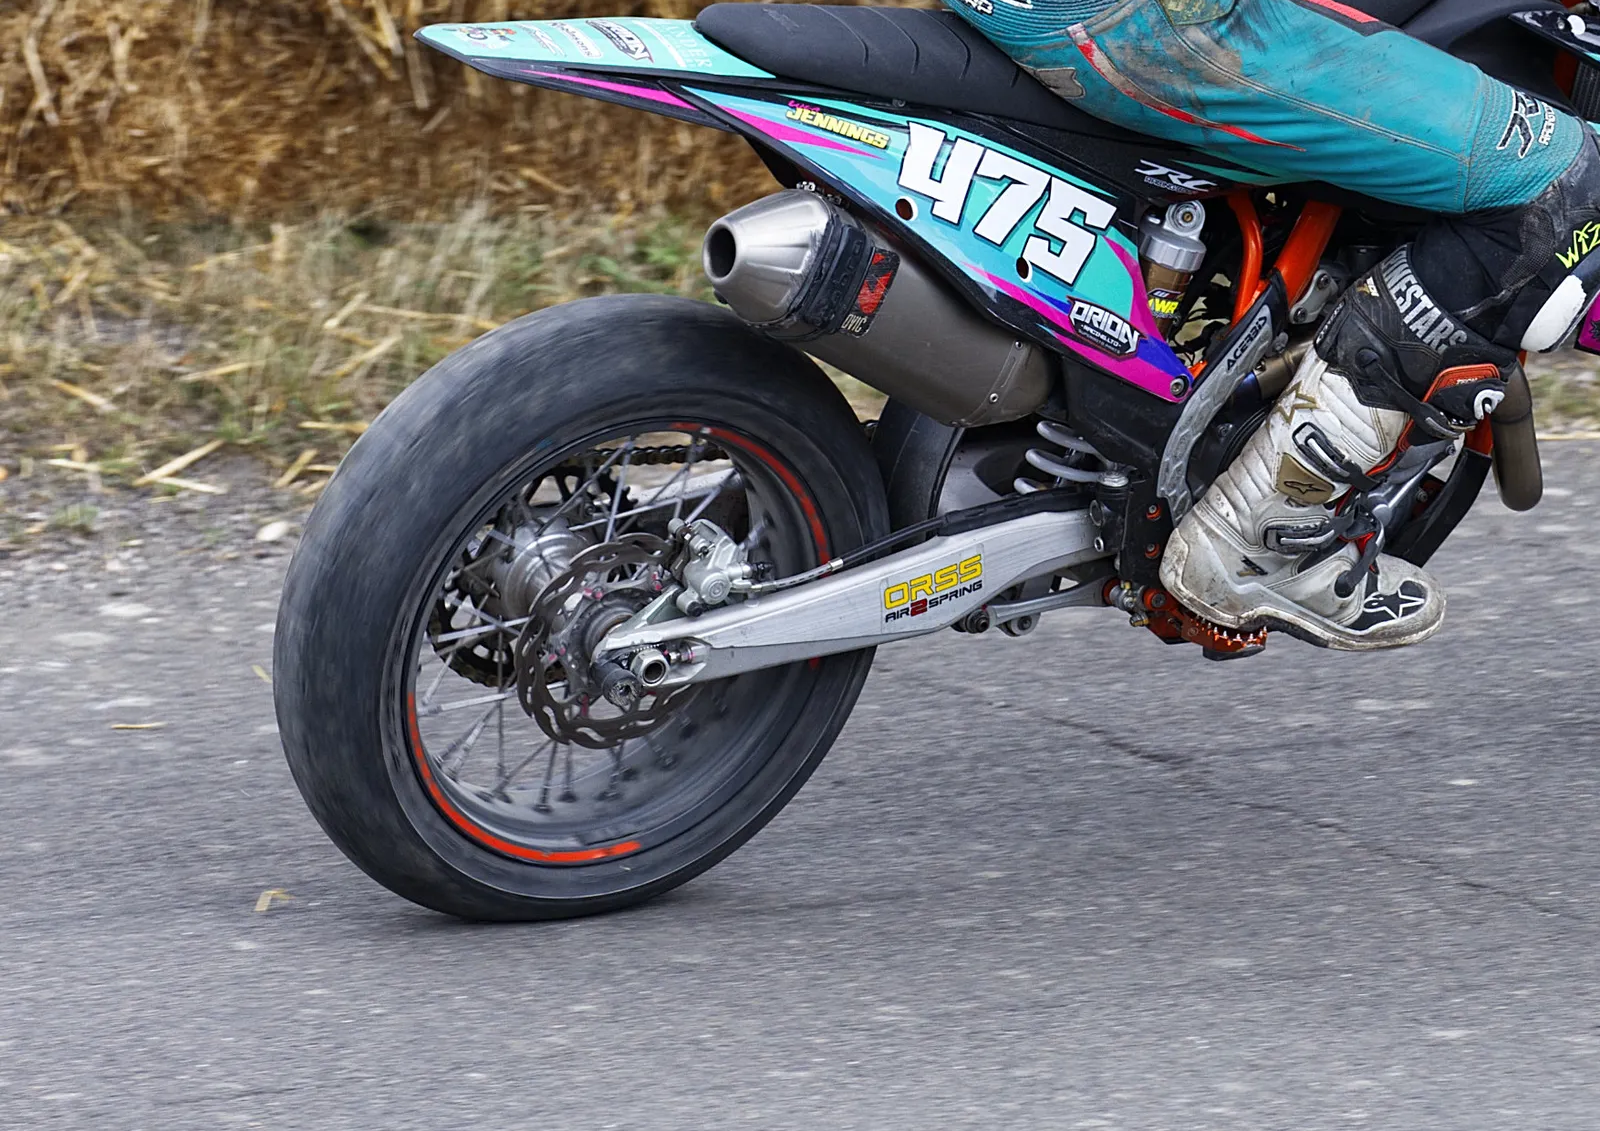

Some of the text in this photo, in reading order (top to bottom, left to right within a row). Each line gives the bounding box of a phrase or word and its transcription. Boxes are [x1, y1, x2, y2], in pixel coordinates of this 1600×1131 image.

[786, 108, 891, 149] JENNINGS
[898, 121, 1117, 285] 475
[1070, 301, 1140, 353] ORION
[1227, 316, 1267, 370] ACERBIS
[884, 554, 982, 609] ORSS
